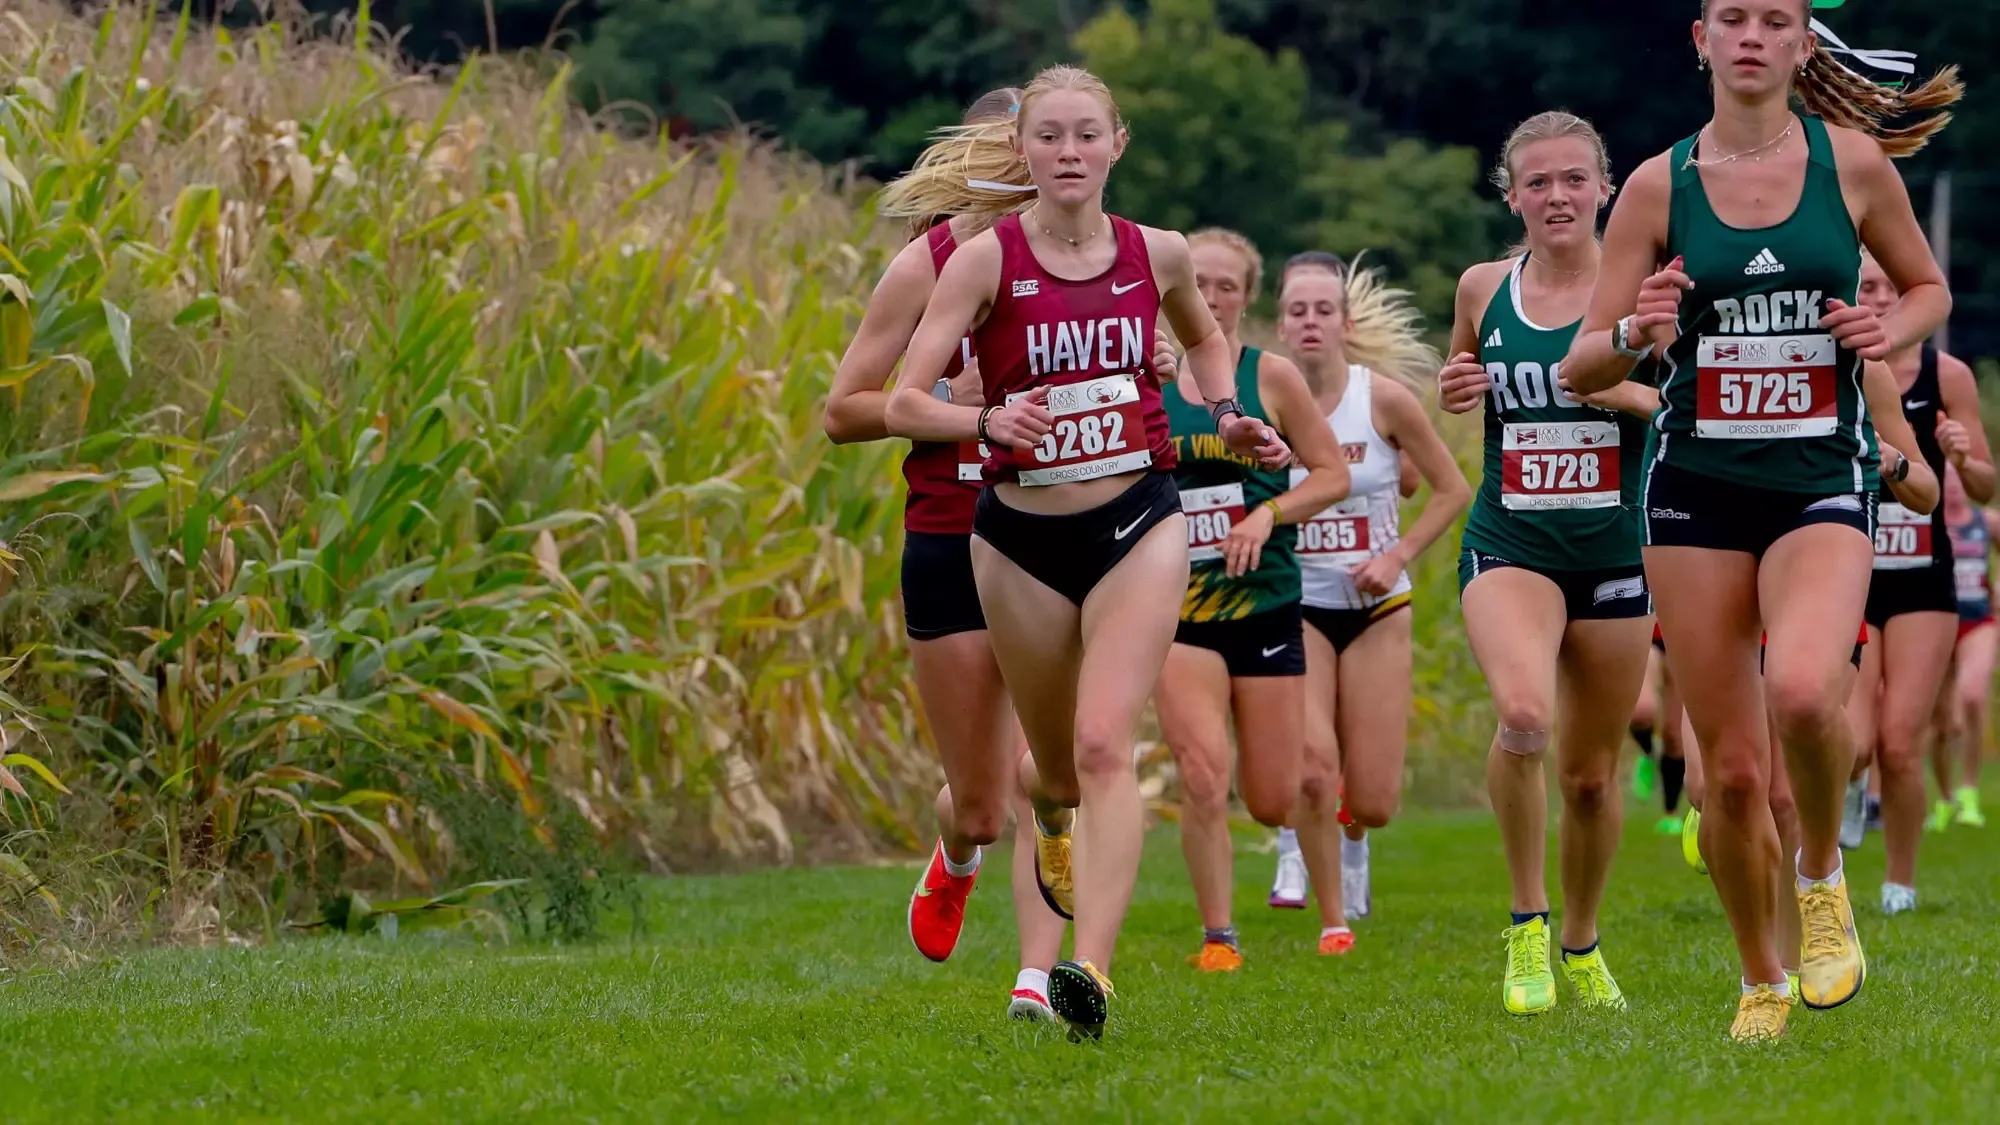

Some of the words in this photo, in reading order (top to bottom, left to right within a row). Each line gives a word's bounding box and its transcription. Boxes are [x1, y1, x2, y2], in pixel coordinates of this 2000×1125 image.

[1744, 263, 1785, 275] adidas
[1012, 283, 1039, 293] PSAC
[1713, 290, 1822, 334] ROCK
[1026, 317, 1143, 375] HAVEN
[1741, 343, 1766, 351] LOCK
[1486, 361, 1618, 414] ROC
[1720, 372, 1812, 415] 5725
[1729, 424, 1759, 435] CROSS
[1760, 423, 1803, 434] COUNTRY
[1050, 470, 1079, 481] CROSS
[1080, 461, 1120, 476] COUNTRY
[1521, 453, 1600, 490] 5728
[1530, 499, 1555, 507] CROSS
[1556, 498, 1592, 506] COUNTRY
[1651, 508, 1690, 519] adidas
[1187, 511, 1231, 544] 780
[1875, 526, 1917, 554] 570
